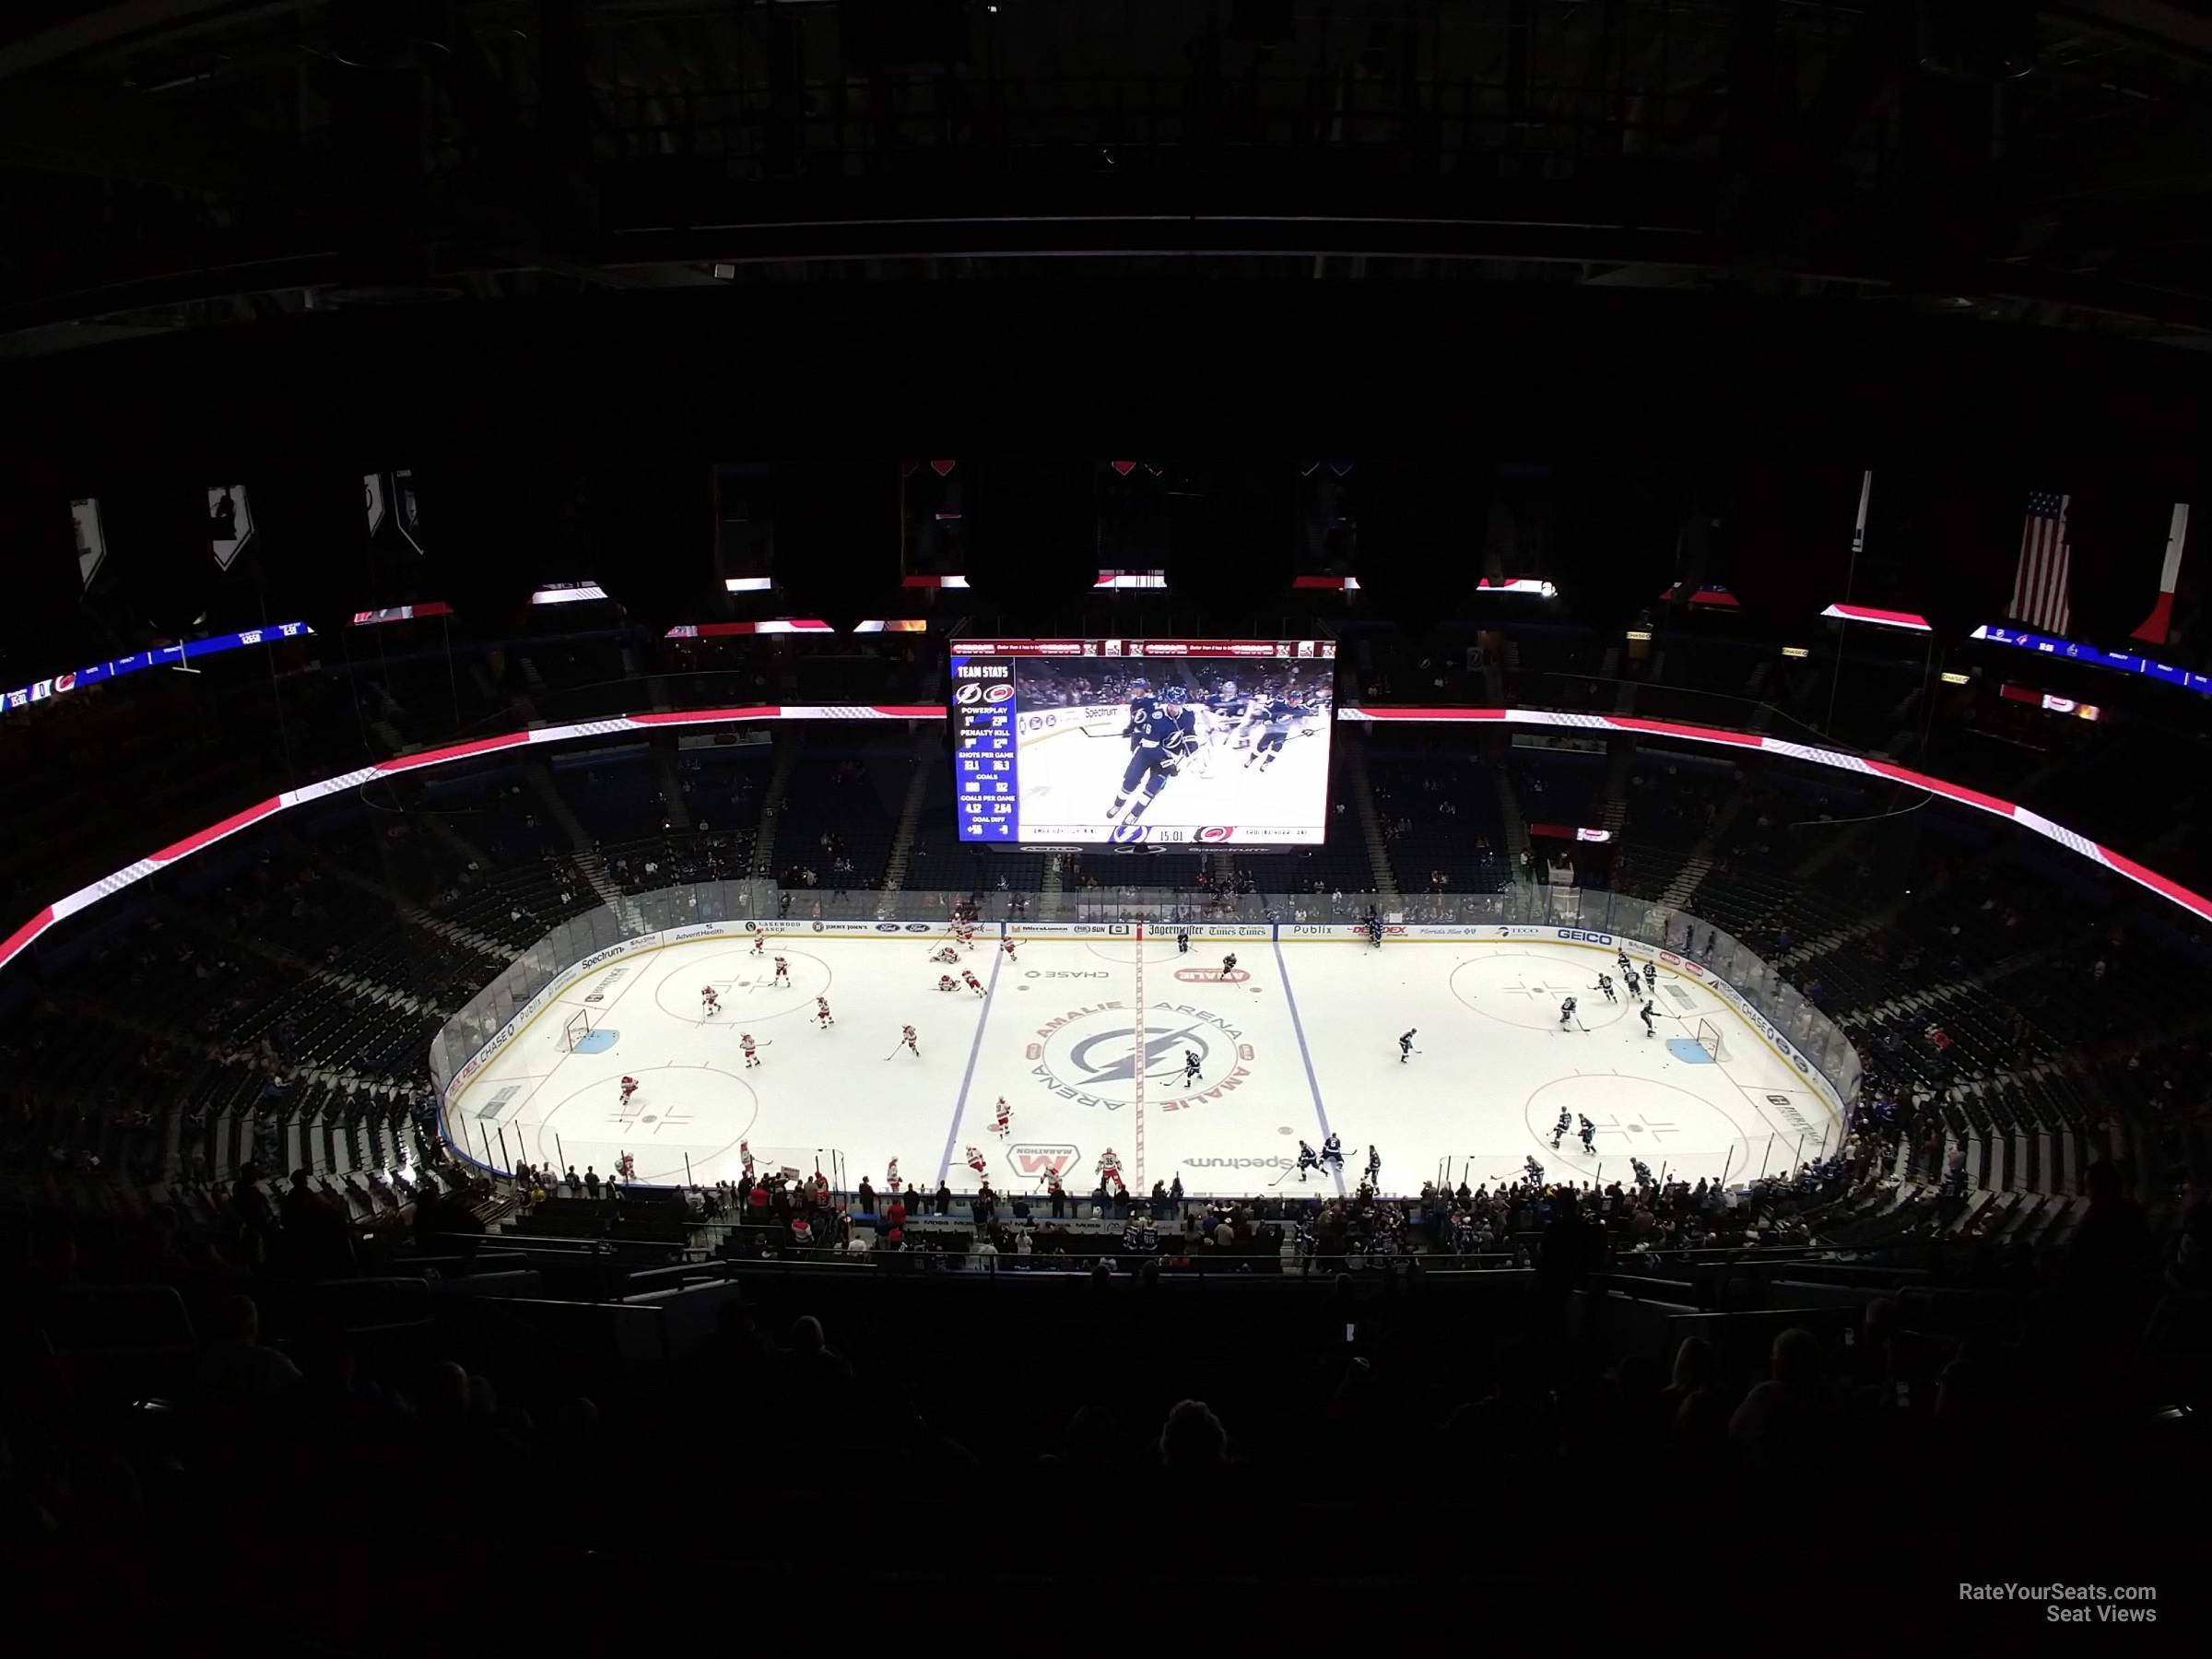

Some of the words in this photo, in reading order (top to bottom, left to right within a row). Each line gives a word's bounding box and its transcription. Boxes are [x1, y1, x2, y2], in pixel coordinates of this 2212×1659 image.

[958, 666, 982, 677] TEAM
[982, 666, 1008, 677] STATS
[676, 927, 724, 941] AdventHealth
[1208, 926, 1237, 935] Times
[1239, 926, 1266, 935] Times
[1293, 925, 1333, 935] Publix
[1419, 927, 1445, 935] Florida
[1557, 929, 1612, 946] GEICO
[582, 946, 623, 970] Spectrum
[1045, 971, 1110, 979] CHASE
[519, 998, 543, 1022] Publix
[1741, 1003, 1767, 1032] CHASE
[1036, 1000, 1123, 1039] AMALIE
[1151, 1001, 1243, 1040] ARENA
[480, 1031, 509, 1063] CHASE
[1031, 1065, 1126, 1111] ARENA
[1159, 1065, 1252, 1112] AMALIE
[1189, 1155, 1294, 1171] Spectrum
